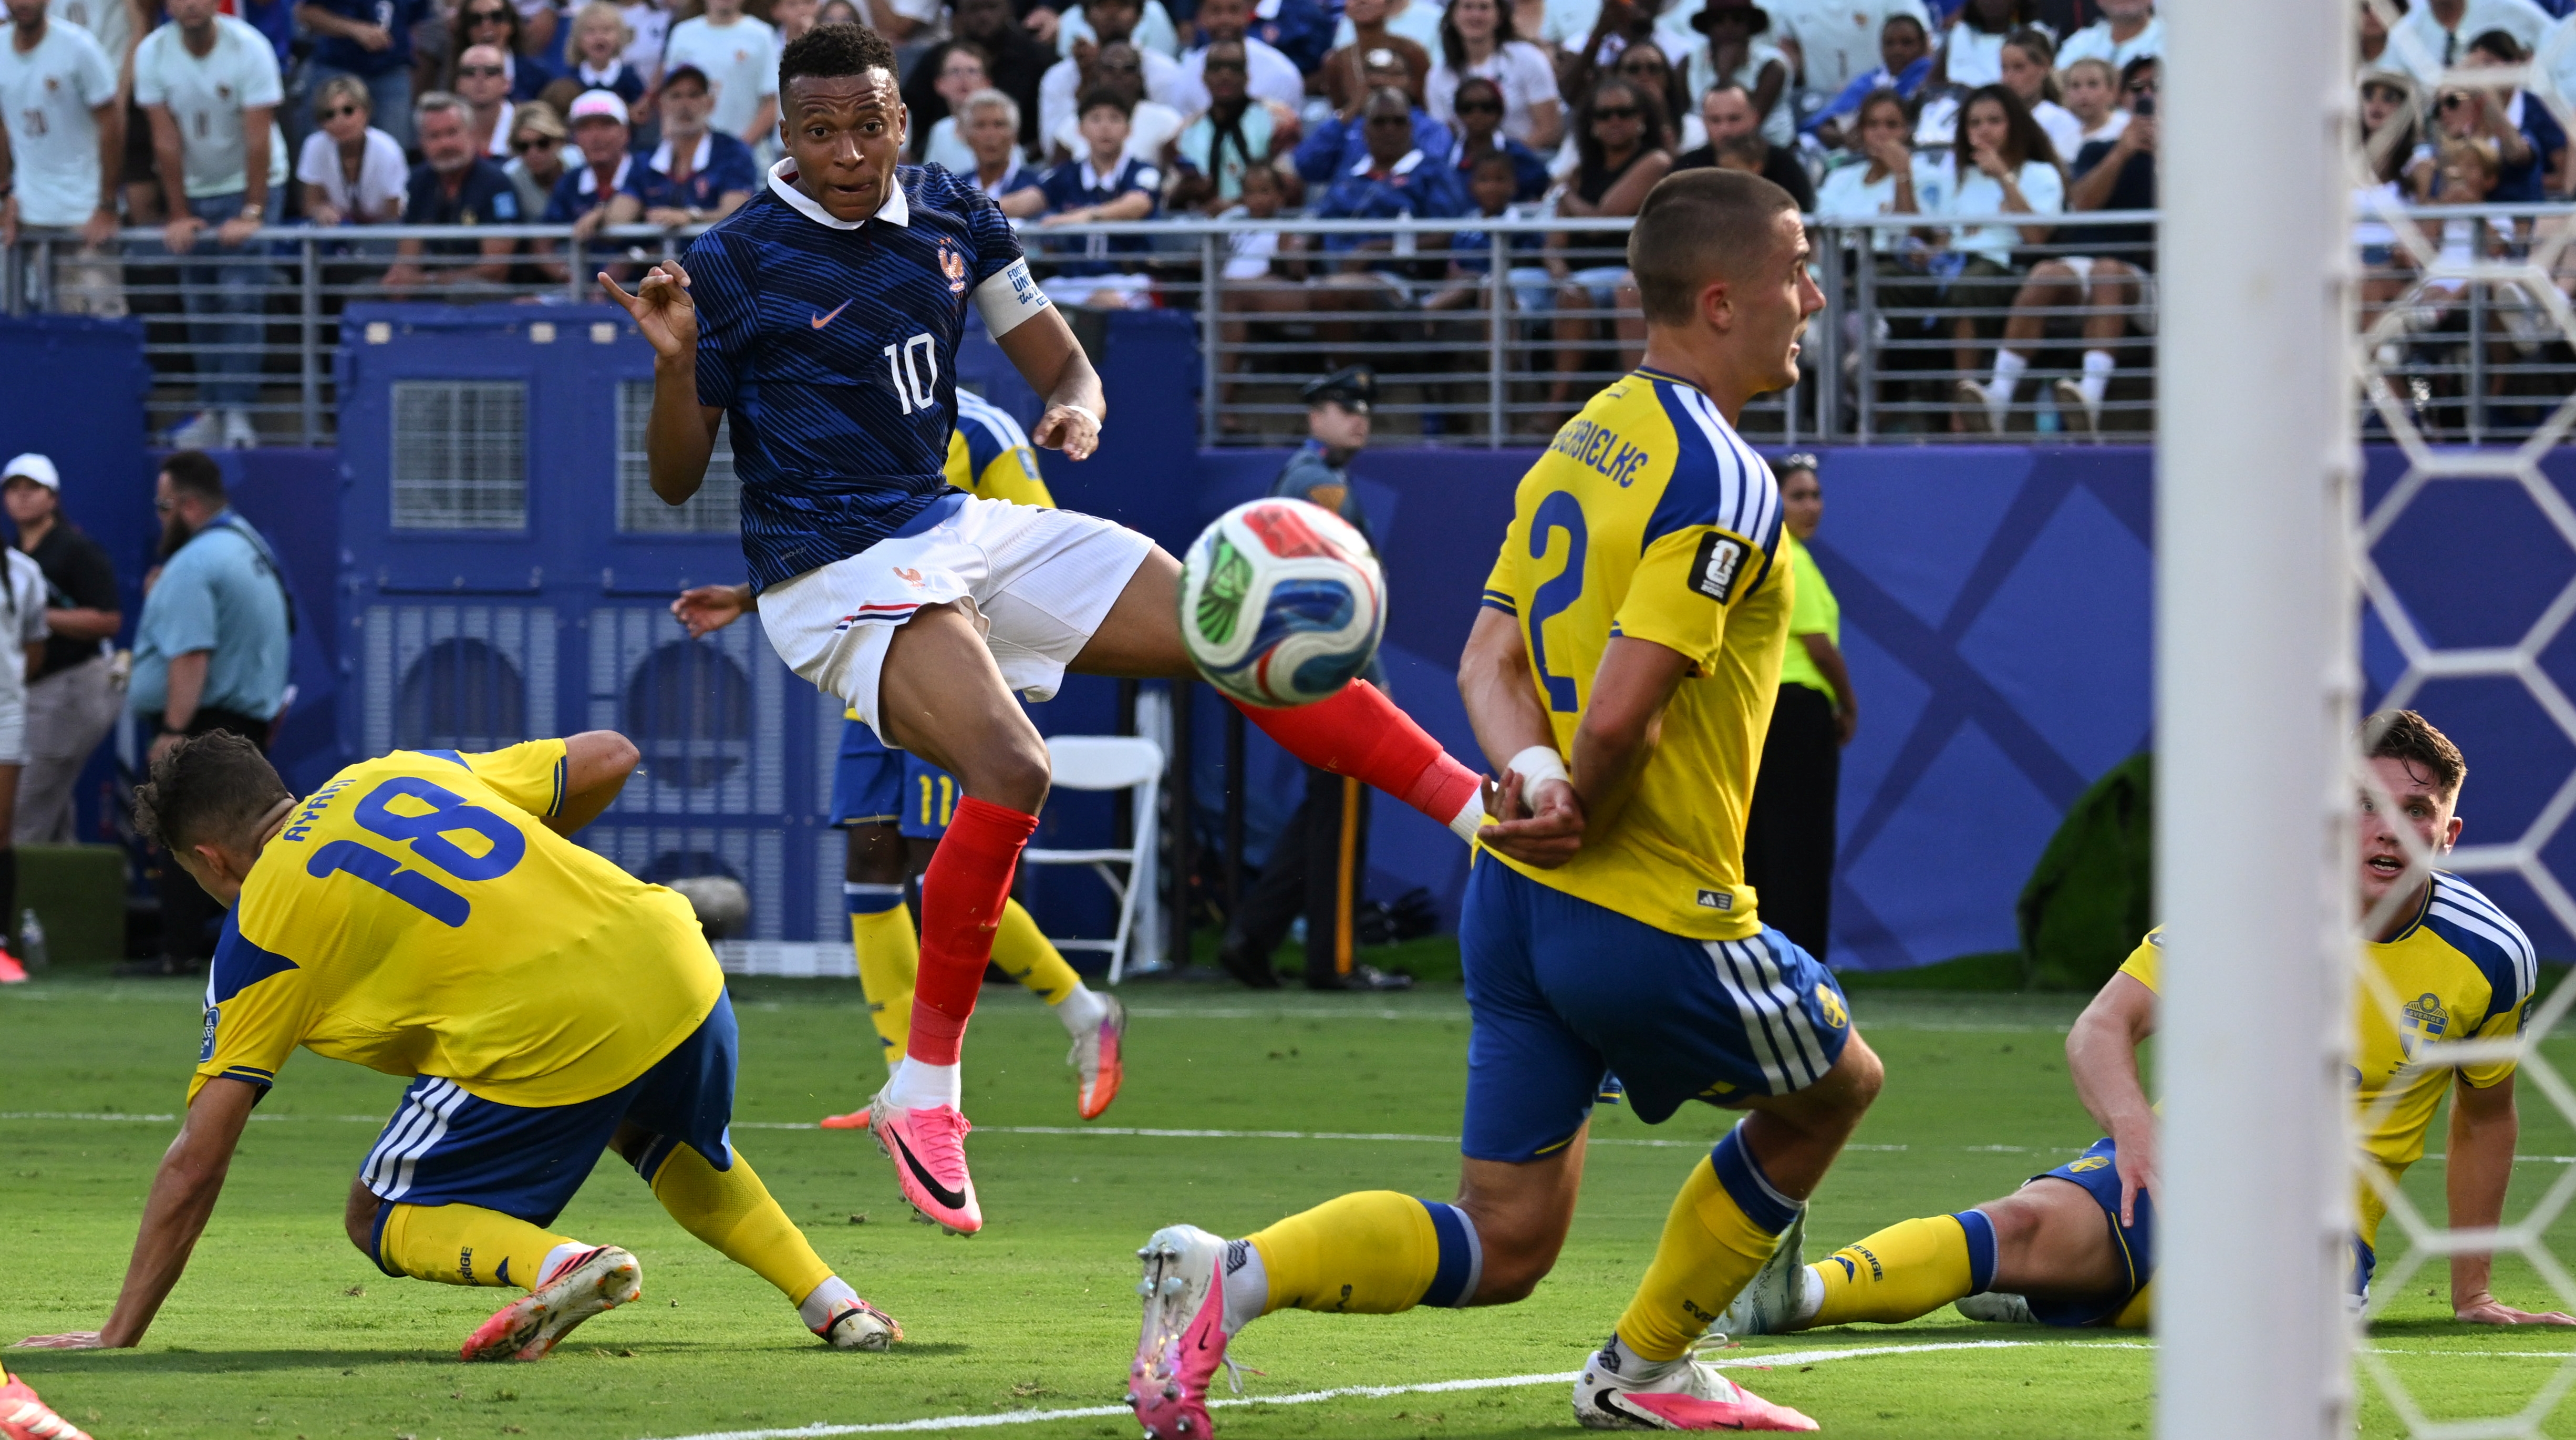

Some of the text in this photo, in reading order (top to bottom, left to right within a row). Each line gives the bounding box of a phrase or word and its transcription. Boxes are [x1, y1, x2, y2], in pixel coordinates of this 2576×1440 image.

[1017, 291, 1033, 304] the
[884, 333, 937, 415] 10
[1529, 490, 1587, 713] 2
[919, 774, 953, 826] 11
[307, 777, 525, 928] 18
[2409, 1010, 2440, 1023] SVERIGE
